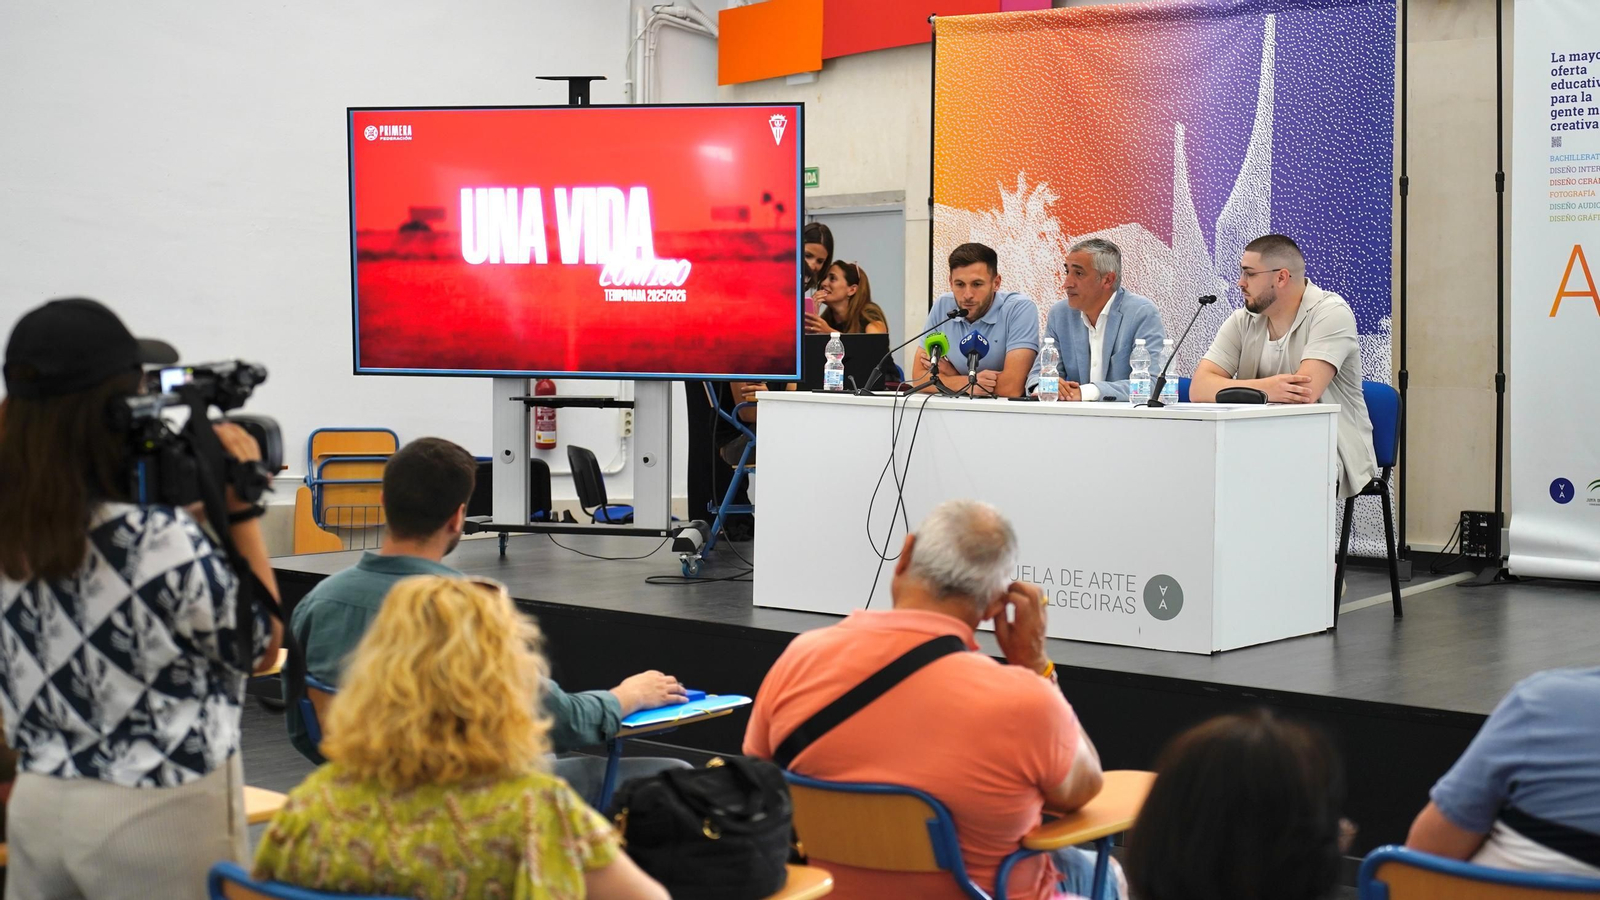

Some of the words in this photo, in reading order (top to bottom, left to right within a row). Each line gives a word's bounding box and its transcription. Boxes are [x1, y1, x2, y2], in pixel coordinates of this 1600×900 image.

[1551, 52, 1566, 63] La
[1550, 65, 1587, 77] oferta
[1550, 94, 1577, 106] para
[1581, 91, 1592, 102] la
[1550, 107, 1584, 120] gente
[379, 125, 412, 136] PRIMERA
[1550, 119, 1599, 131] creativa
[1550, 165, 1577, 174] DISEÑO
[1550, 177, 1577, 186] DISEÑO
[1578, 177, 1600, 185] CERÁ
[1550, 189, 1596, 198] FOTOGRAFÍA
[1550, 201, 1577, 210] DISEÑO
[1550, 214, 1577, 222] DISEÑO
[460, 187, 548, 265] UNA
[554, 186, 655, 265] VIDA
[604, 288, 646, 302] TEMPORADA
[647, 288, 687, 302] 2025/2026
[1010, 564, 1055, 585] UELA
[1061, 568, 1084, 587] DE
[1088, 571, 1136, 593] ARTE
[1047, 589, 1136, 615] LGECIRAS
